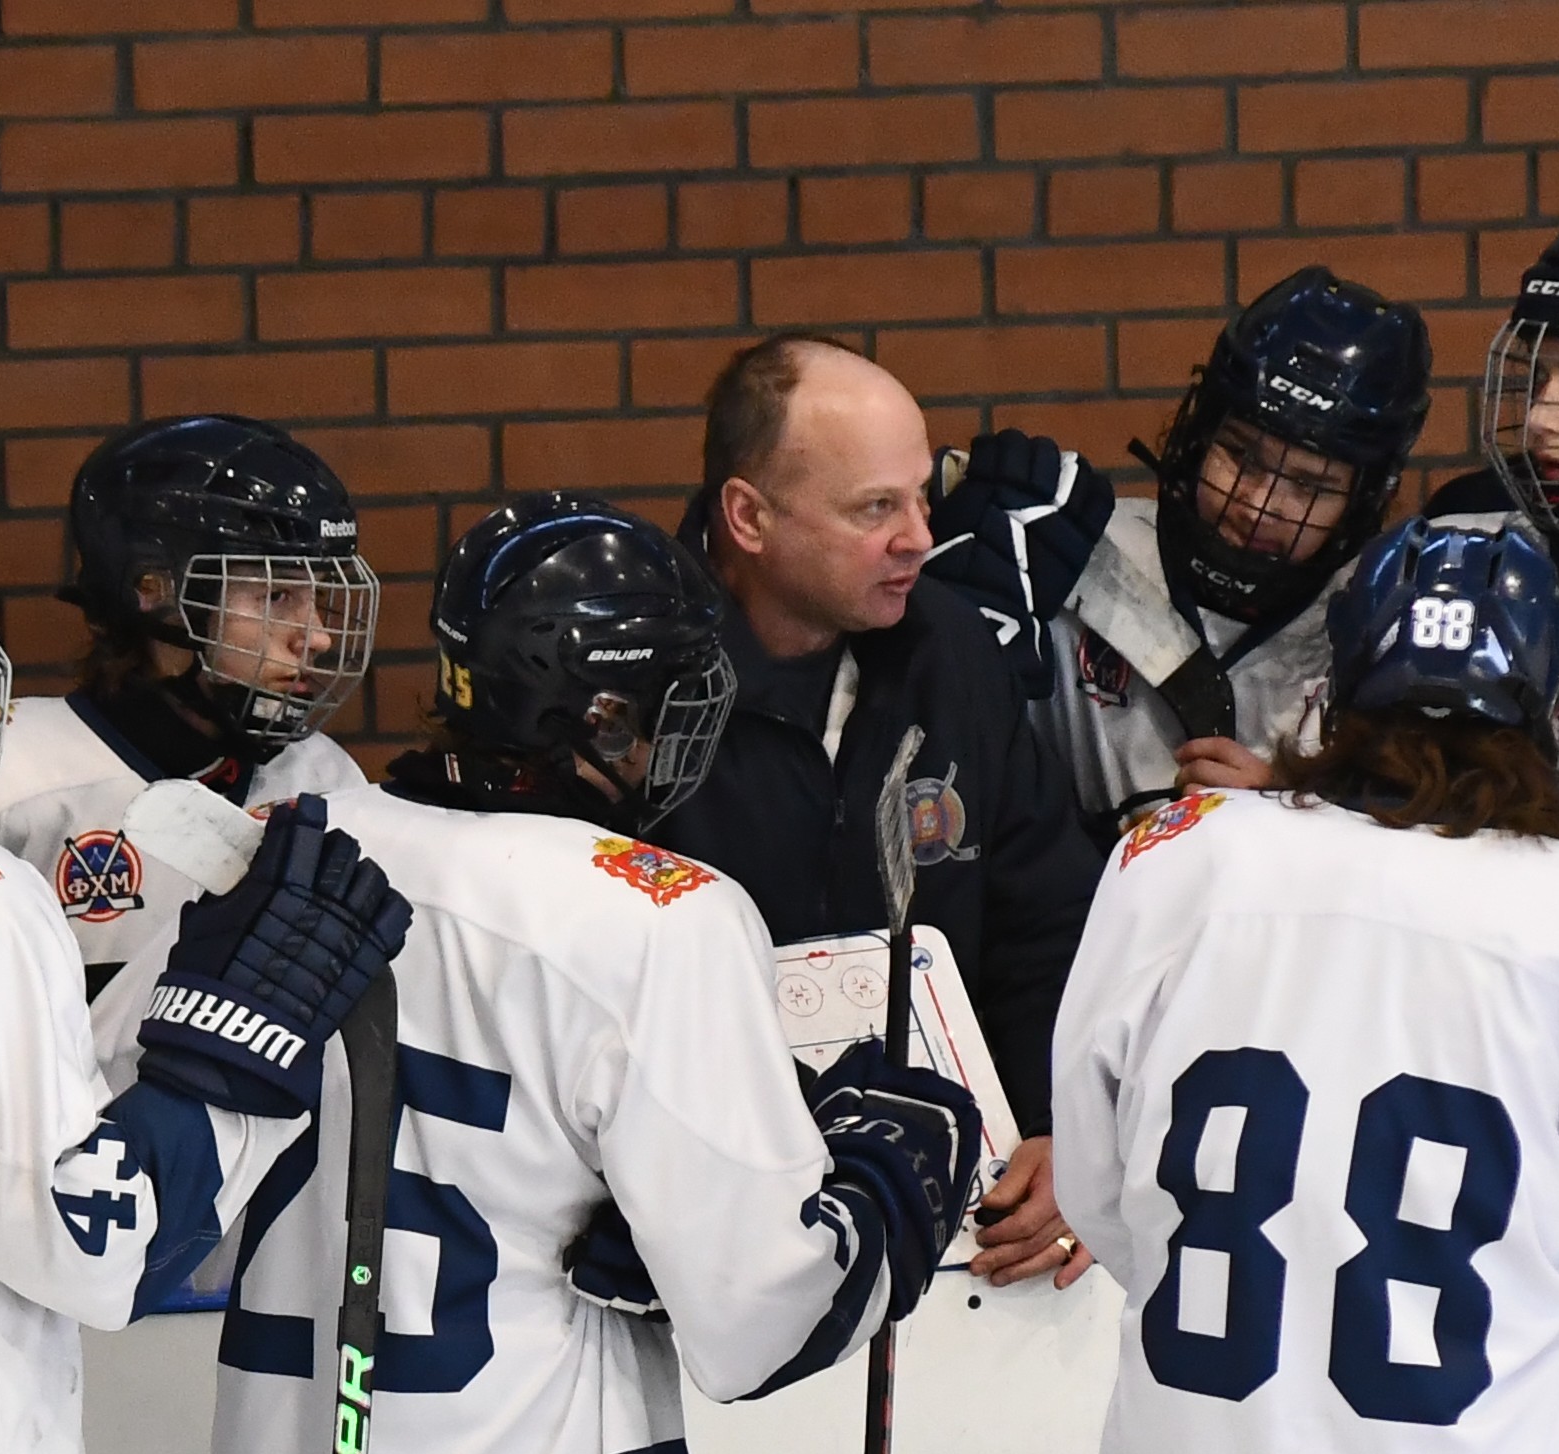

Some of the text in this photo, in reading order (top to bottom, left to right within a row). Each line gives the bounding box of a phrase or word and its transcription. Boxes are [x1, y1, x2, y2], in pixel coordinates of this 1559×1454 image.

[1269, 374, 1335, 412] CCM
[1410, 596, 1476, 651] 88
[586, 648, 654, 662] BAUER
[66, 873, 132, 898] ФХМ
[1141, 1046, 1522, 1427] 88
